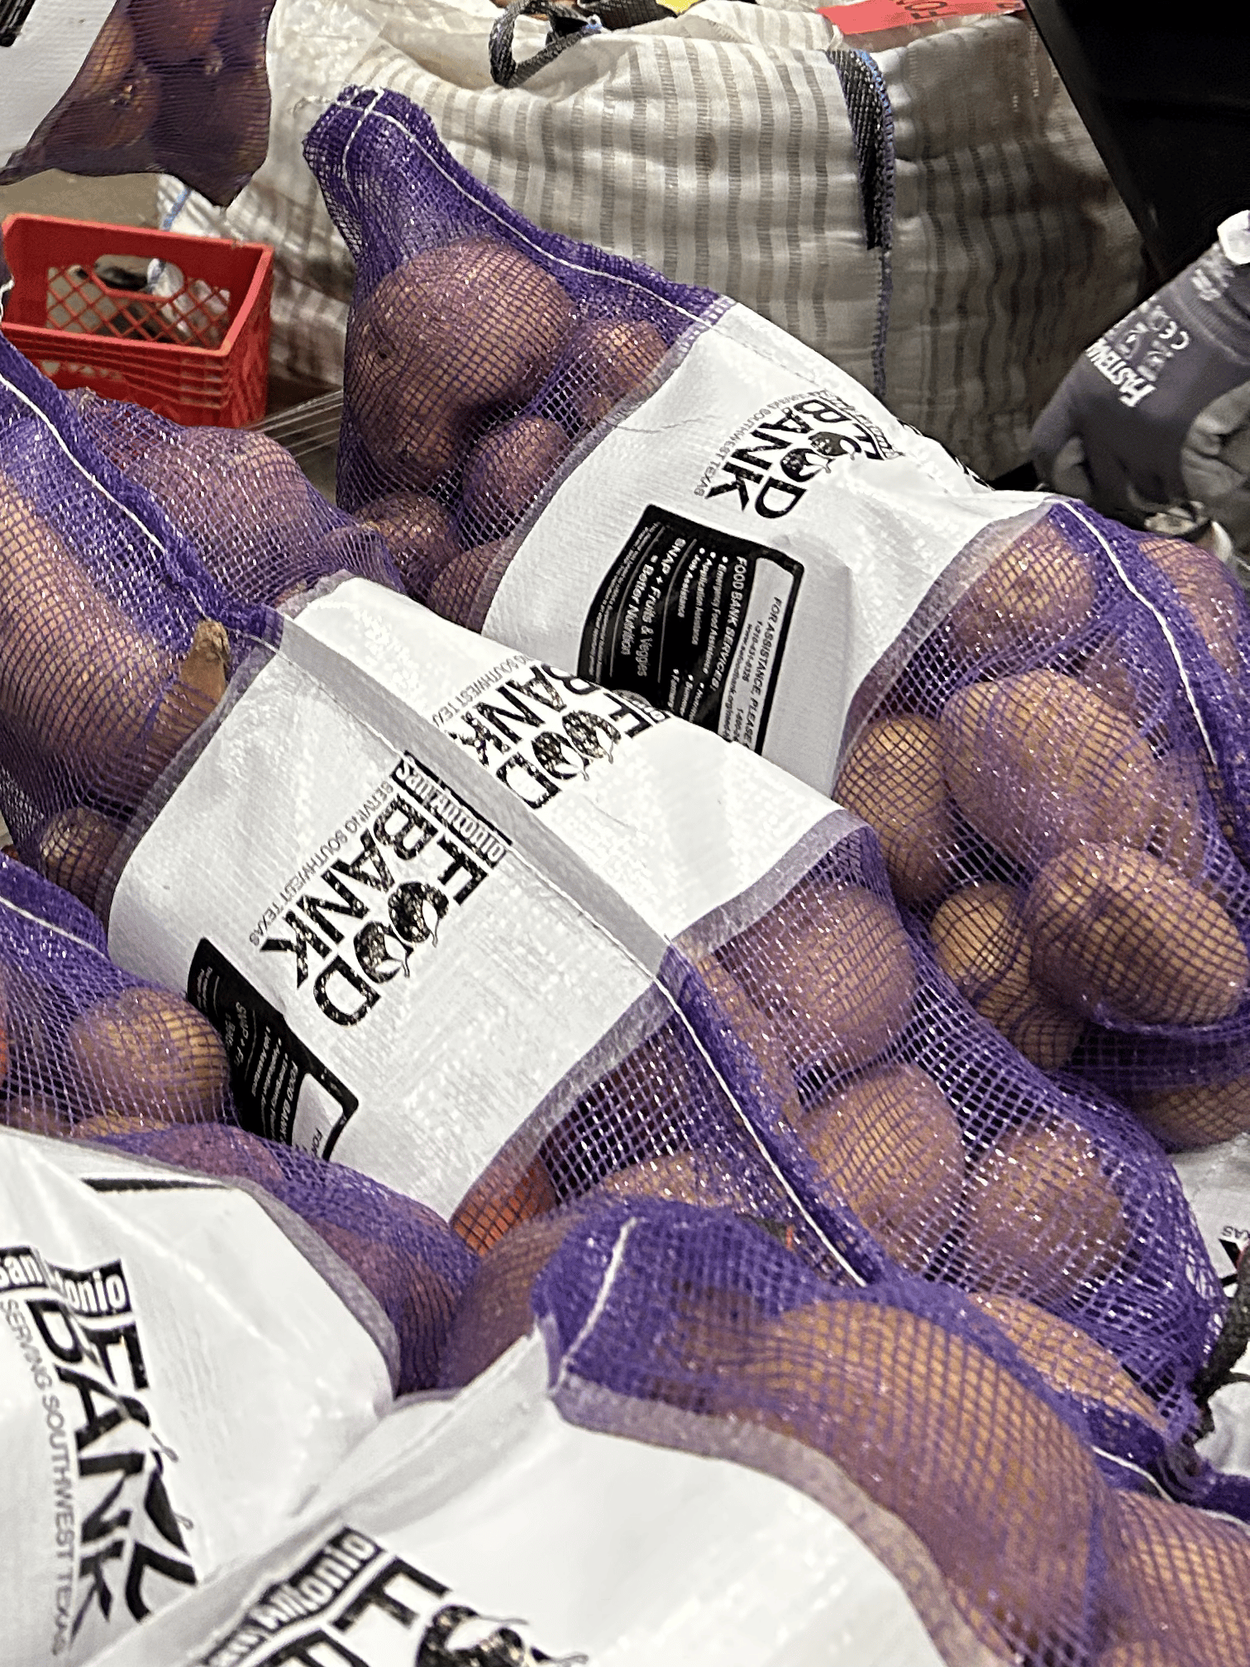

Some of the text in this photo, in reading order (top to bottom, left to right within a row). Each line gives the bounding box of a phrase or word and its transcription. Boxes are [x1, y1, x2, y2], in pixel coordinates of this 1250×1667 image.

[693, 461, 720, 497] TEXAS
[705, 399, 850, 510] BANK
[753, 423, 884, 516] FOOD
[658, 537, 685, 575] SNAP
[695, 557, 713, 606] Application
[733, 556, 748, 590] FOOD
[630, 563, 653, 602] Better
[641, 585, 662, 623] Fruits
[676, 553, 700, 617] Job Assistance
[726, 590, 742, 626] BANK
[620, 603, 639, 656] Nutrition
[640, 625, 653, 636] &
[701, 563, 727, 674] Emergency Food Assistance
[636, 636, 651, 677] Veggies
[742, 597, 781, 743] FOR ASSISTANCE, PLEASE
[454, 659, 516, 706] SOUTHWEST
[494, 693, 652, 812] FOOD
[247, 780, 394, 946] SERVING SOUTHWEST TEXAS
[258, 794, 439, 990] BANK
[306, 835, 488, 1026] FOOD
[283, 1061, 299, 1099] FOOD
[43, 1396, 73, 1560] SOUTHWEST
